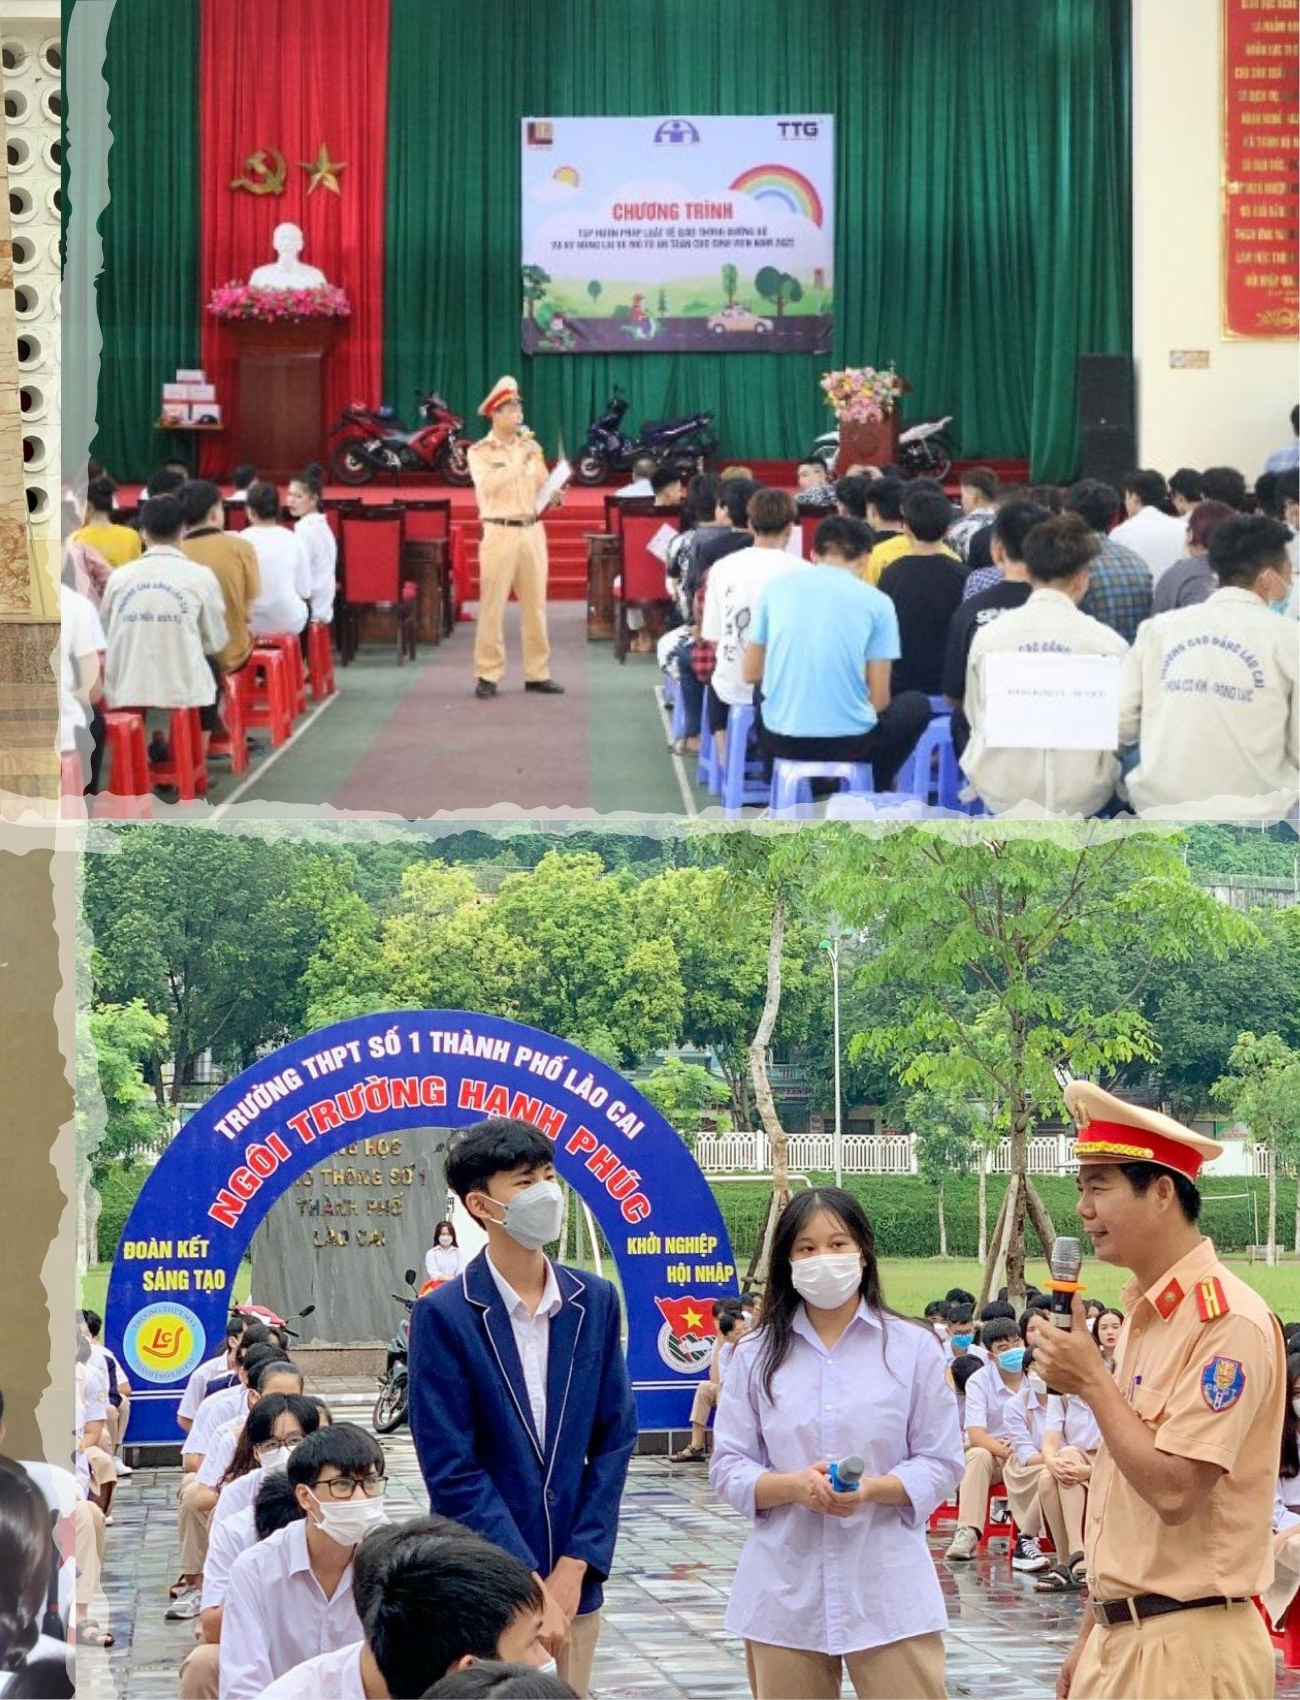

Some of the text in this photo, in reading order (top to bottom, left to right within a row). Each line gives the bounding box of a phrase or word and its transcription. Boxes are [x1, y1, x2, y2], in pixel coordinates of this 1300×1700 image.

[777, 121, 819, 137] TTG
[613, 199, 733, 221] CHƯƠNG TRÌNH
[214, 1025, 646, 1142] TRƯỜNG THPT SỐ 1 THÀNH PHỐ LÀO CAI
[208, 1075, 652, 1229] NGÔI TRƯỜNG HẠNH PHÚC
[123, 1234, 210, 1260] ĐOÀN KẾT
[627, 1231, 718, 1258] KHỞI NGHIỆP
[143, 1266, 226, 1294] SÁNG TẠO
[667, 1262, 734, 1286] HỘI NHẬP
